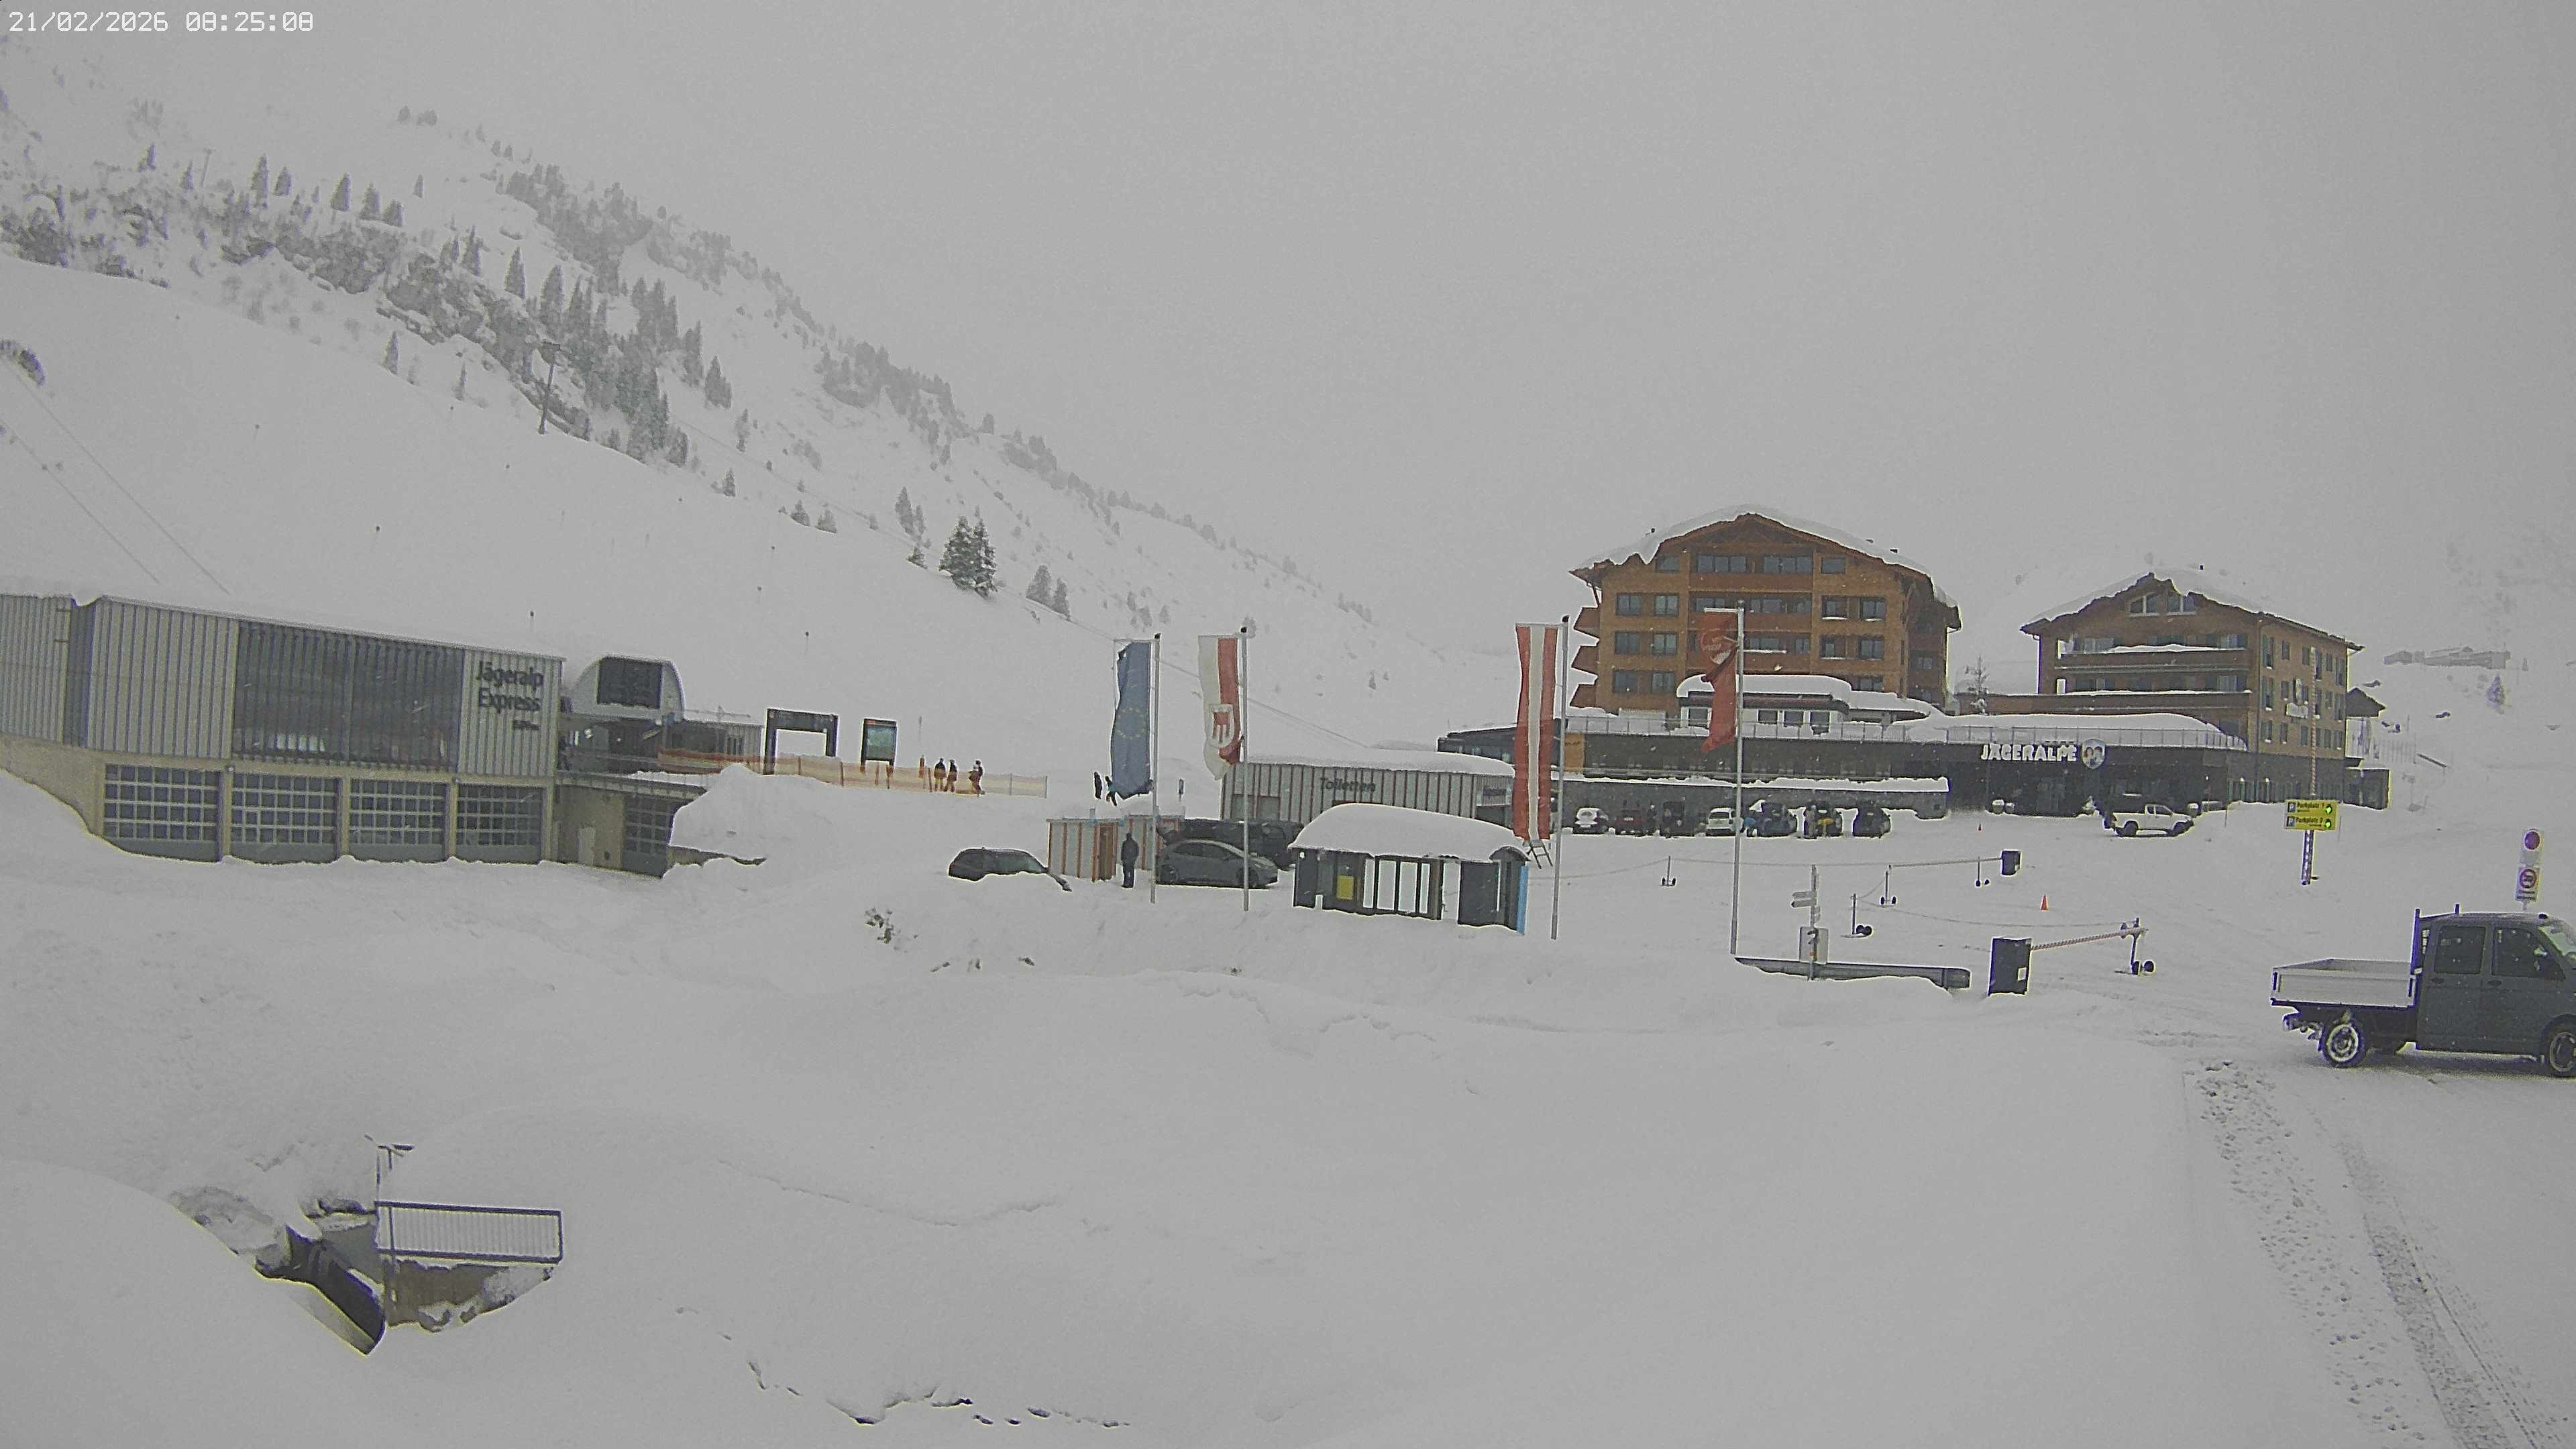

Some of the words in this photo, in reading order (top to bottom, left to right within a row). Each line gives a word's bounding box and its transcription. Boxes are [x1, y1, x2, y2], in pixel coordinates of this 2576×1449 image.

[476, 660, 543, 692] Jägeralp
[478, 687, 541, 714] Express
[1980, 742, 2077, 762] JÄGERALPE
[1320, 777, 1375, 792] Toiletten
